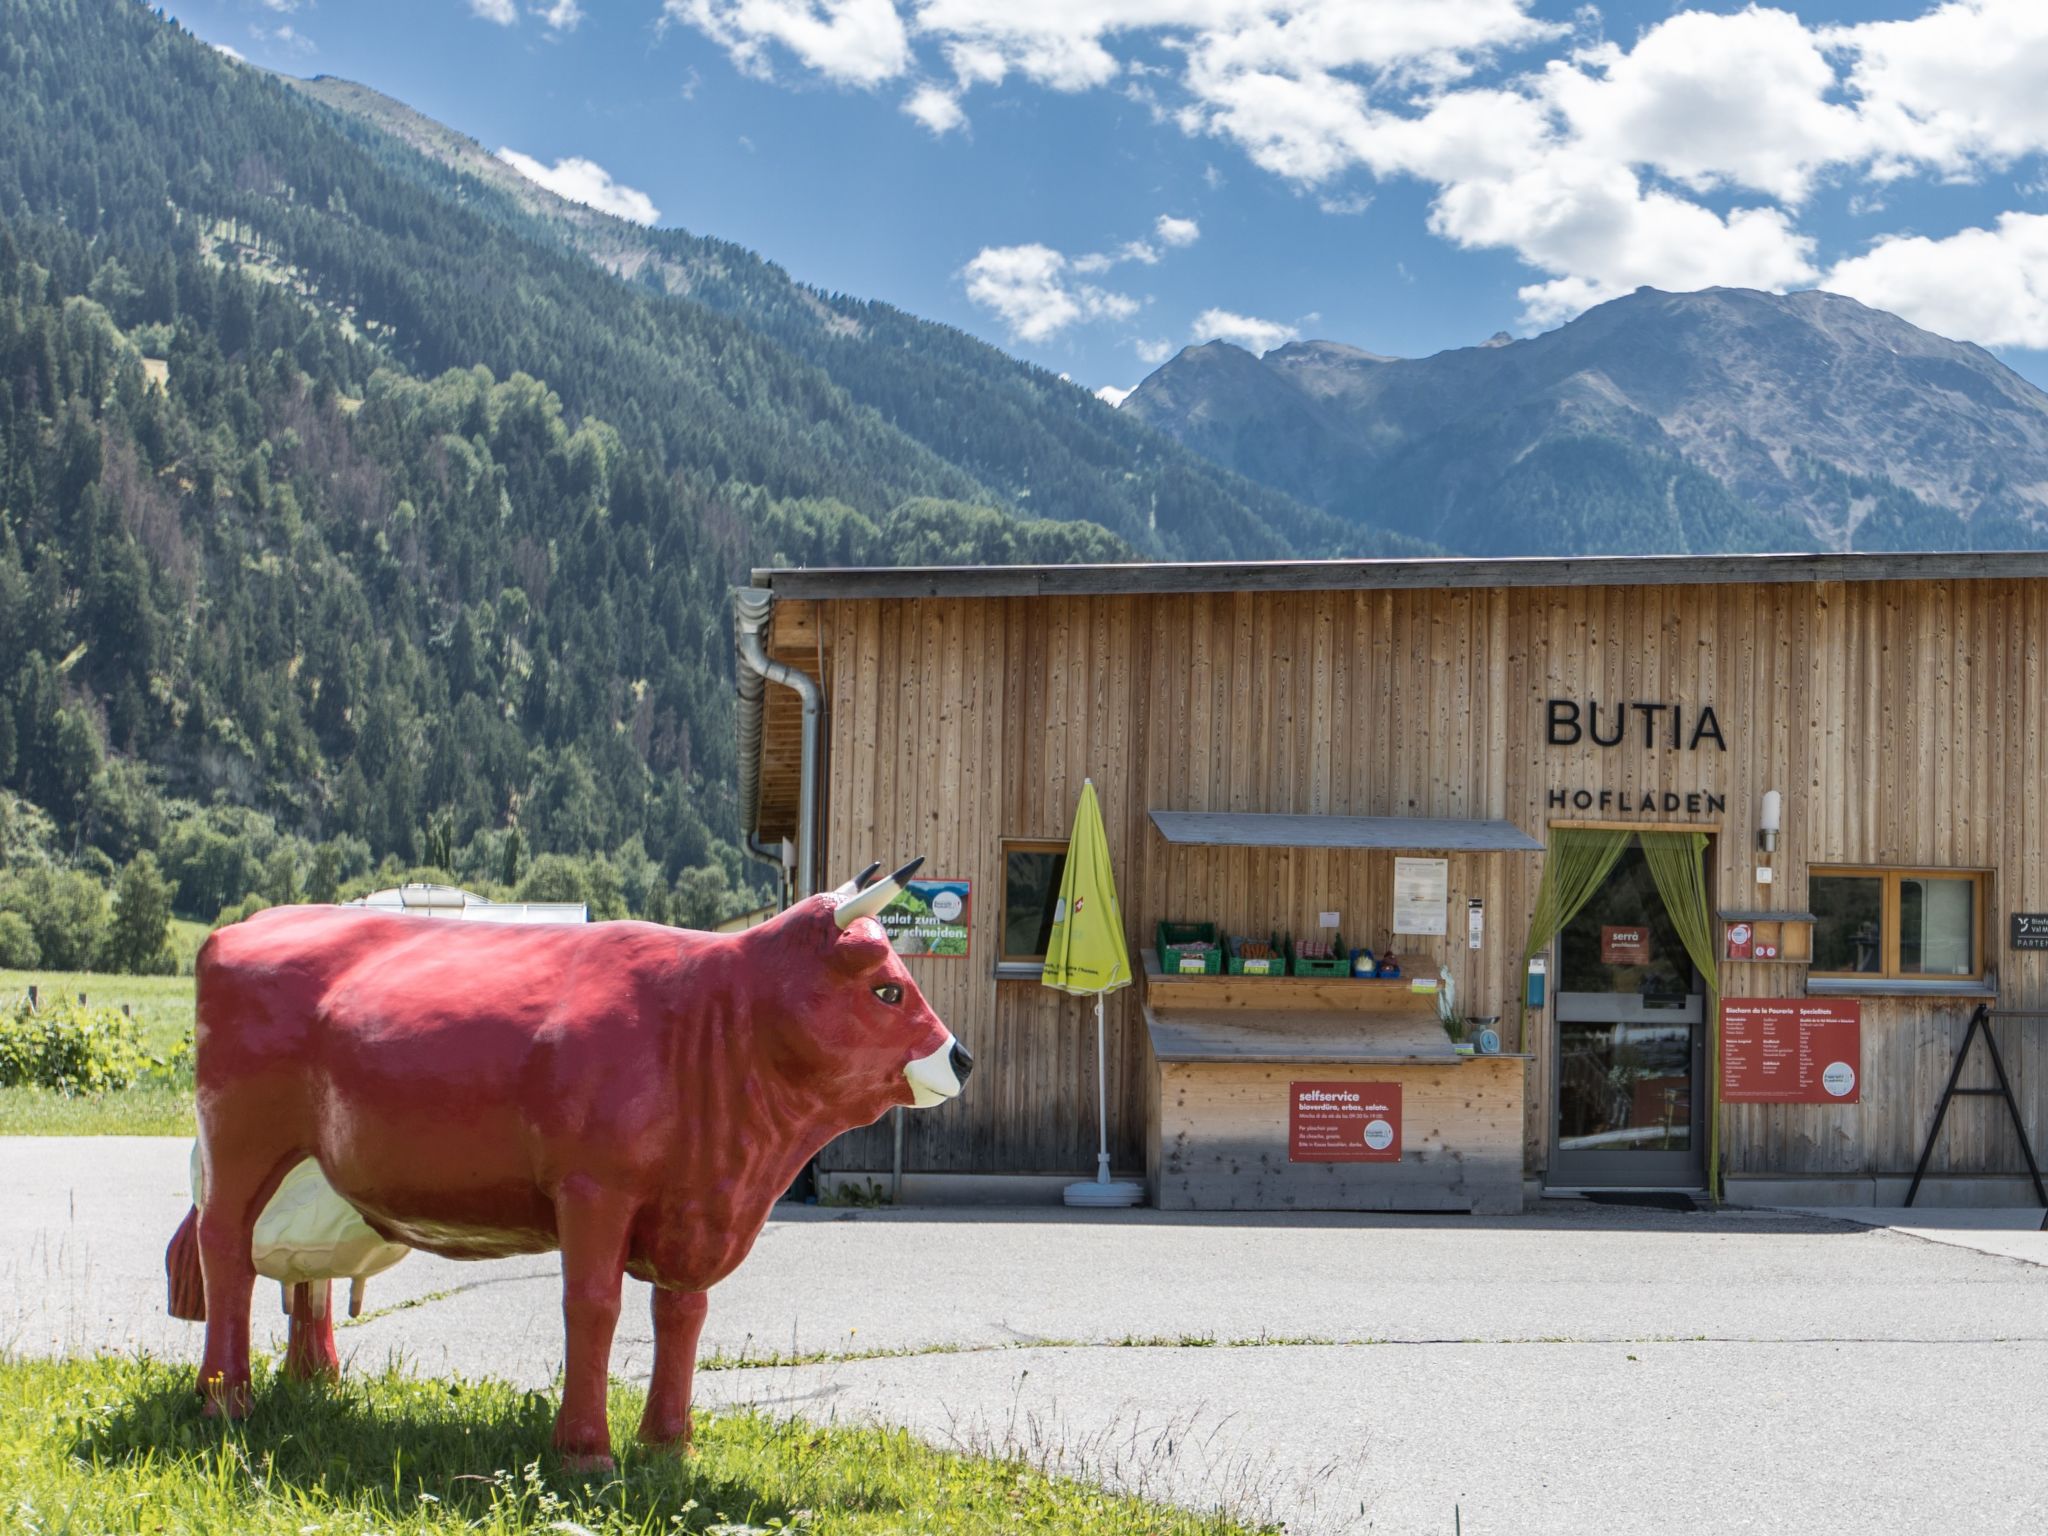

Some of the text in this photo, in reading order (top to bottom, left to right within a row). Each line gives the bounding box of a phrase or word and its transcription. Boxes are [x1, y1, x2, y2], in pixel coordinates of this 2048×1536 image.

[1548, 700, 1727, 752] BUTIA
[1549, 789, 1726, 814] HOFLADEN
[914, 915, 941, 925] zum
[904, 926, 967, 938] schneiden.
[1299, 1090, 1360, 1102] selfservice
